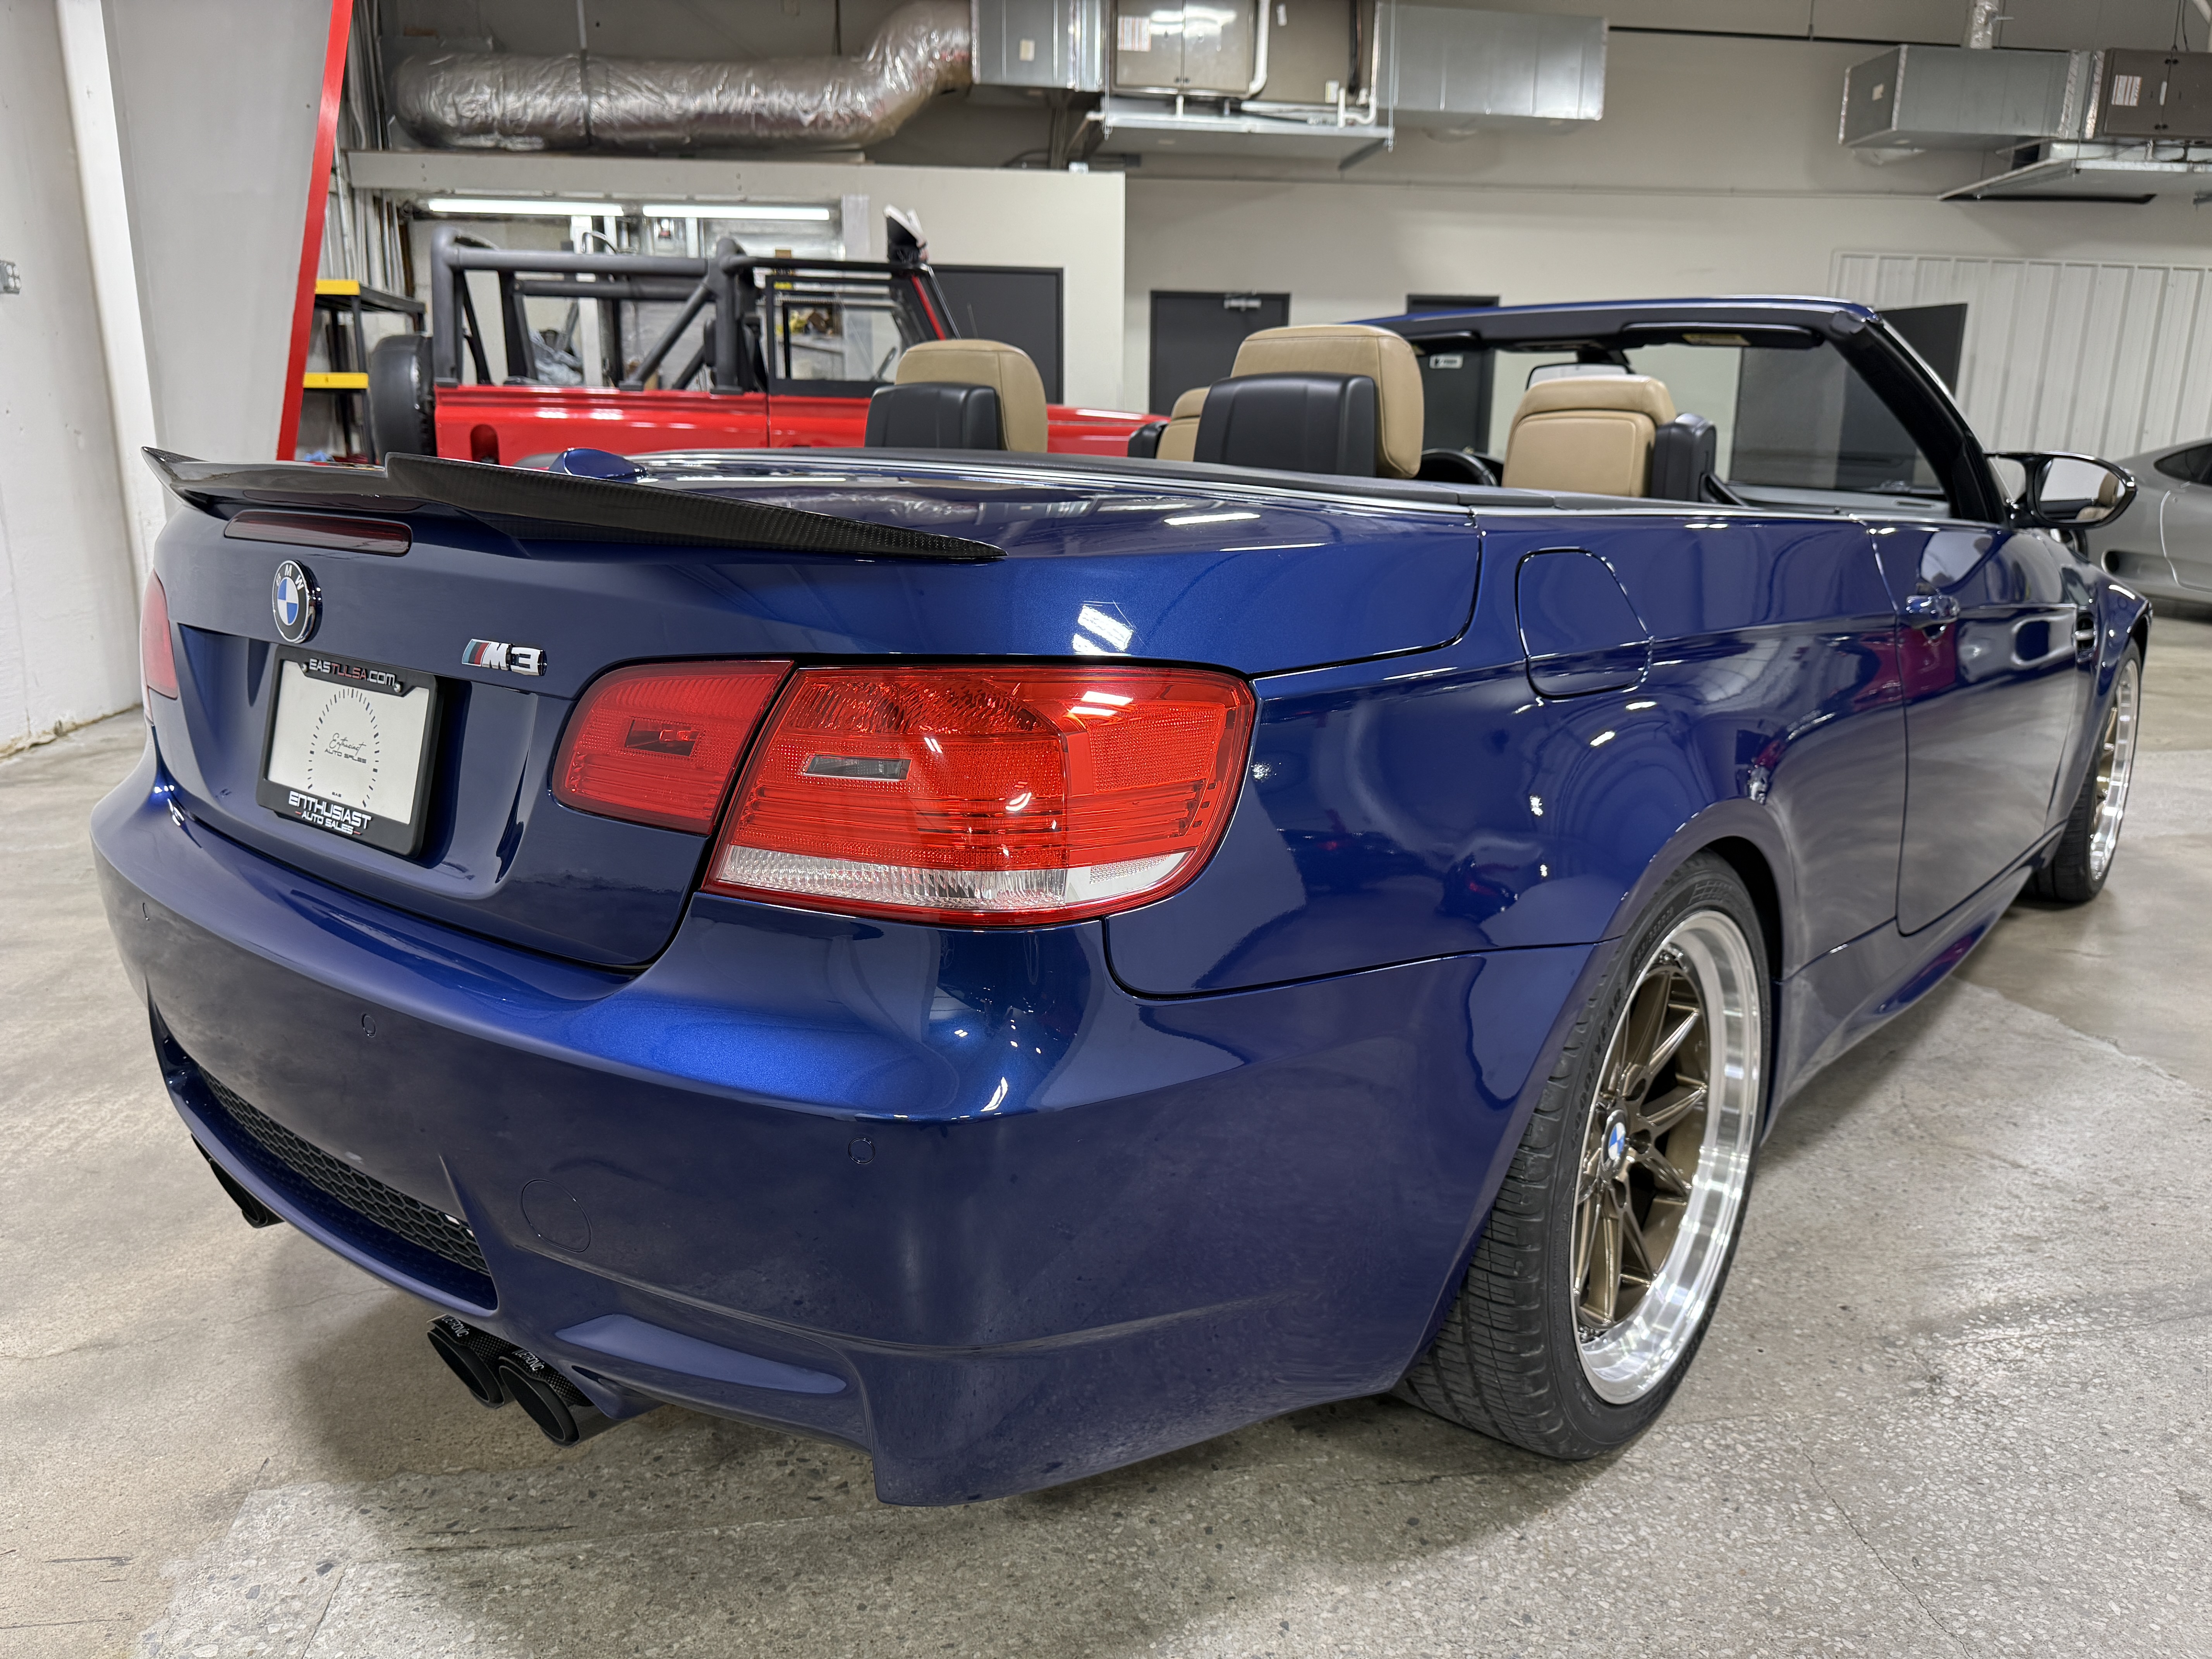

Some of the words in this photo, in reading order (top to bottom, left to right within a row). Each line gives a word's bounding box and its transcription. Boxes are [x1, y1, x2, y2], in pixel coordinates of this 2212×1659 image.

[276, 564, 304, 590] BMW
[309, 658, 395, 686] EASTULSA.COM
[481, 641, 543, 676] M3
[325, 748, 342, 757] AUTO
[343, 753, 367, 764] SALES
[289, 791, 371, 829] ENTHUSIAST
[302, 811, 325, 825] AUTO
[325, 818, 354, 835] SALES
